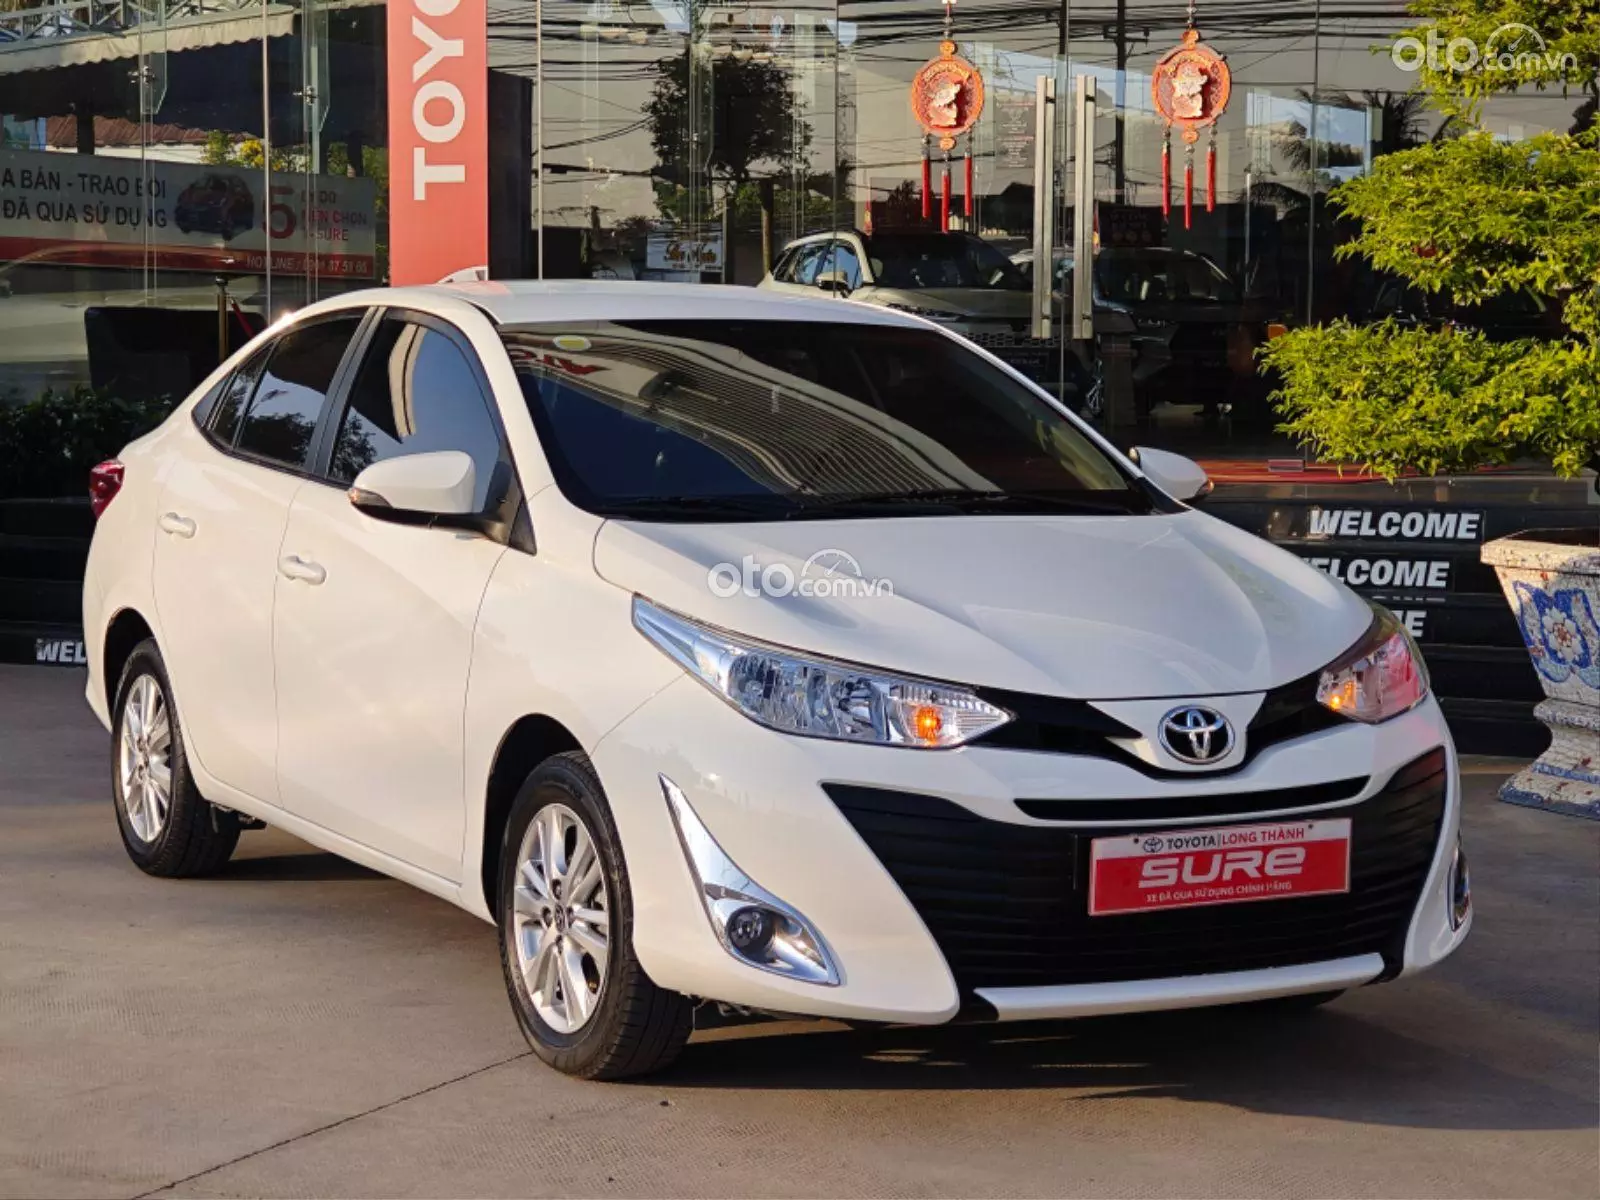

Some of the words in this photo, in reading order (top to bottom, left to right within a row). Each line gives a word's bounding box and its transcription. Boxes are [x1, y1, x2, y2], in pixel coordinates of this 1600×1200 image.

[412, 0, 466, 201] TOY
[20, 165, 61, 190] BÁN
[77, 173, 130, 196] TRAO
[2, 196, 31, 220] ĐÃ
[36, 200, 79, 223] QUA
[262, 185, 297, 239] 5
[1308, 509, 1481, 540] WELCOME
[1301, 556, 1451, 588] ELCOME
[1167, 835, 1217, 850] TOYOTA
[1221, 831, 1258, 846] LONG
[1260, 826, 1306, 842] THÀNH
[1173, 888, 1194, 901] QUA
